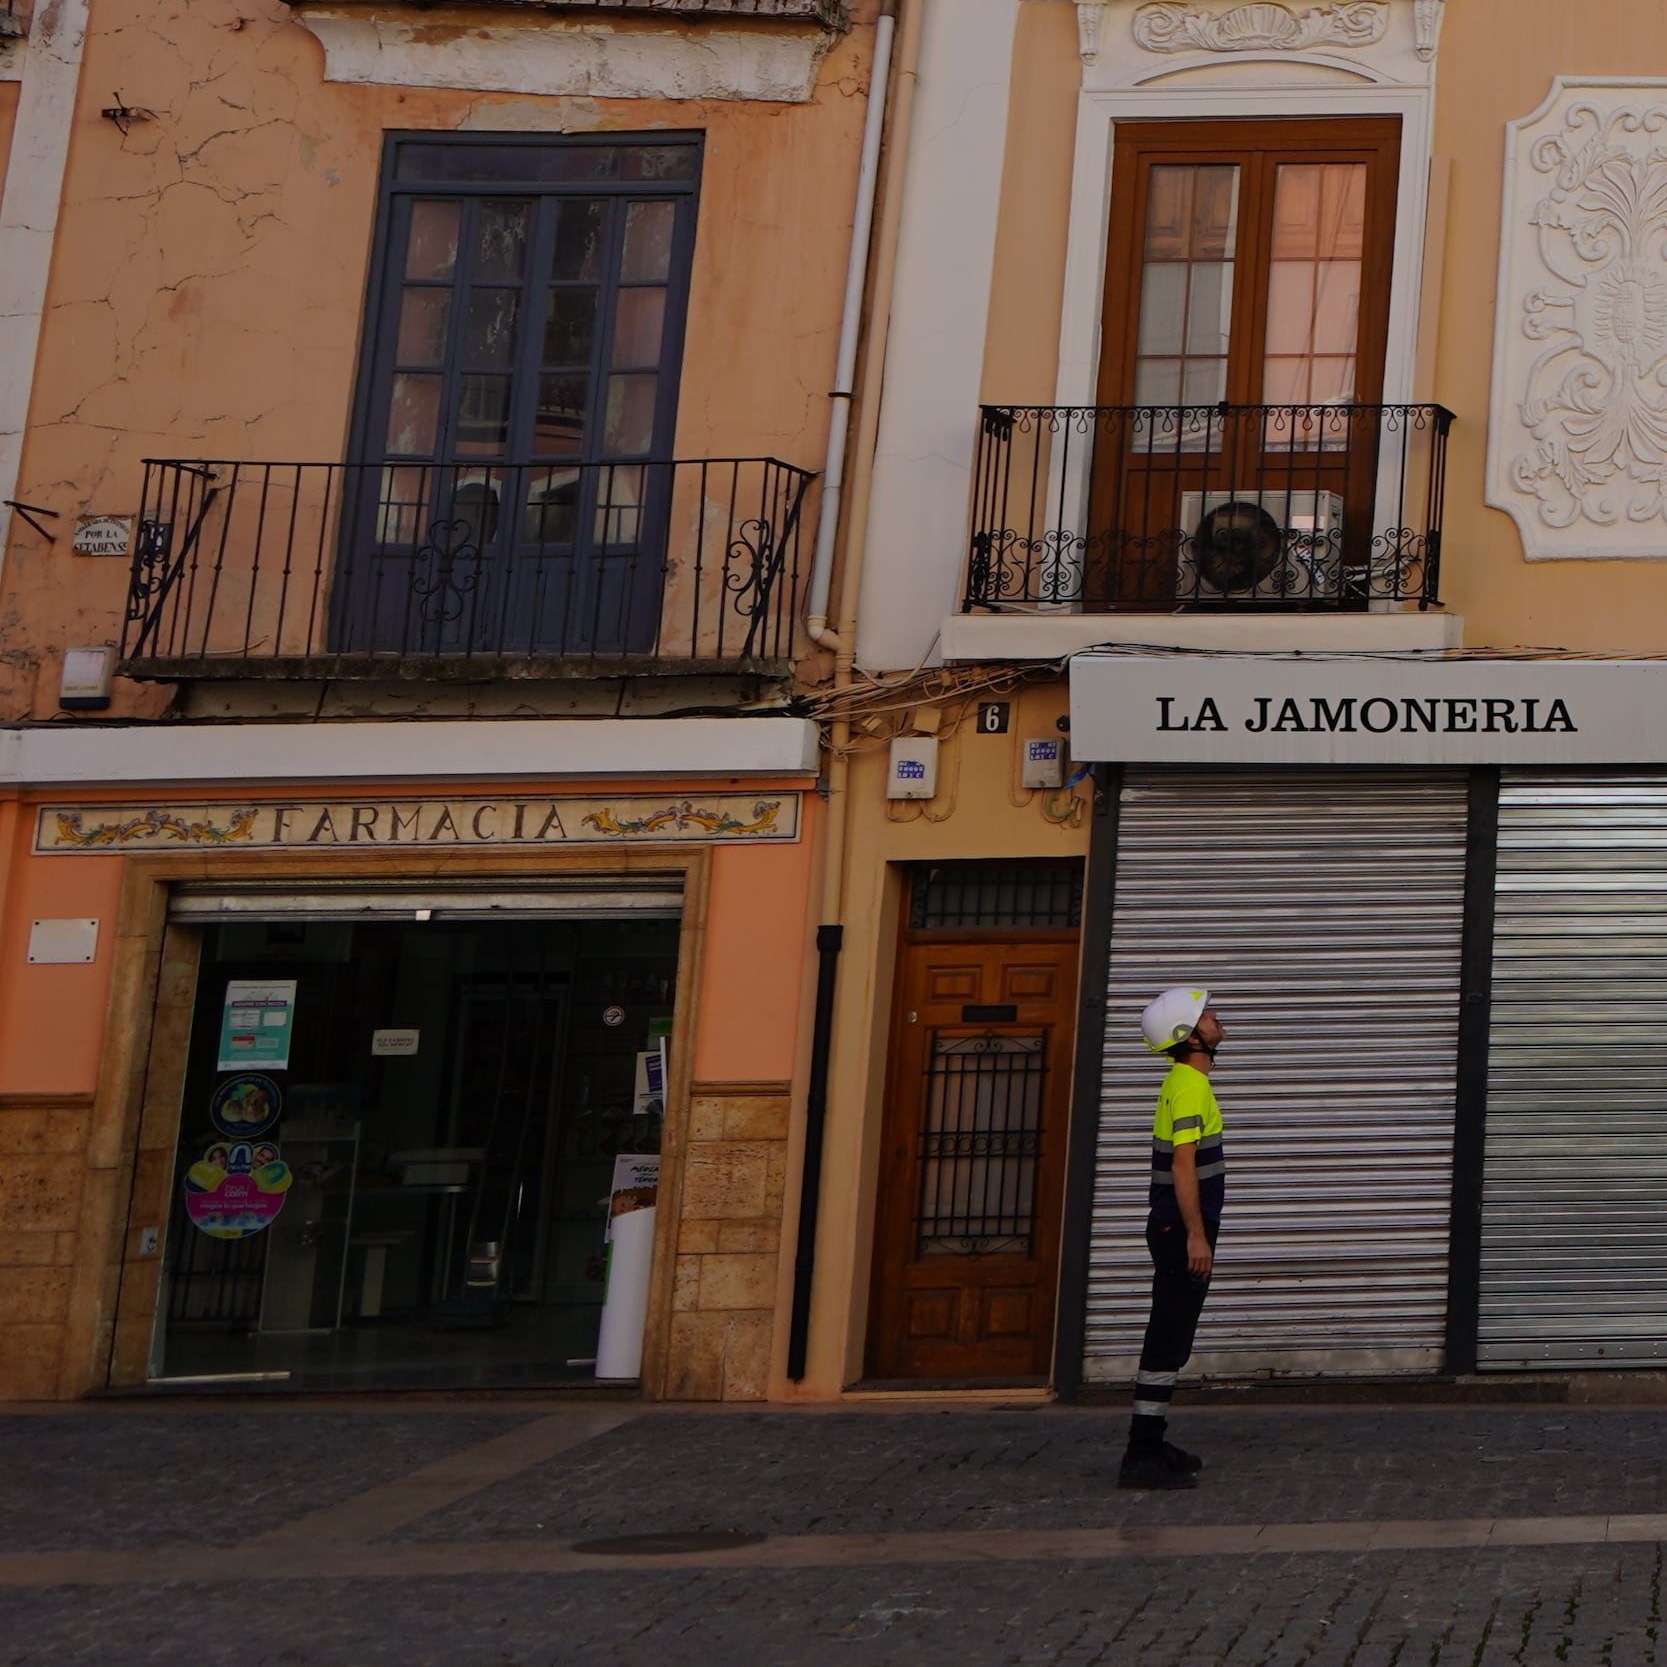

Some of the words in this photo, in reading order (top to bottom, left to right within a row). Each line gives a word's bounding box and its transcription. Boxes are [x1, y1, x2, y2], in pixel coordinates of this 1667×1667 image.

[985, 705, 1000, 732] 6
[1156, 697, 1228, 731] LA
[1245, 697, 1579, 733] JAMONERIA
[271, 804, 567, 842] FARMACIA
